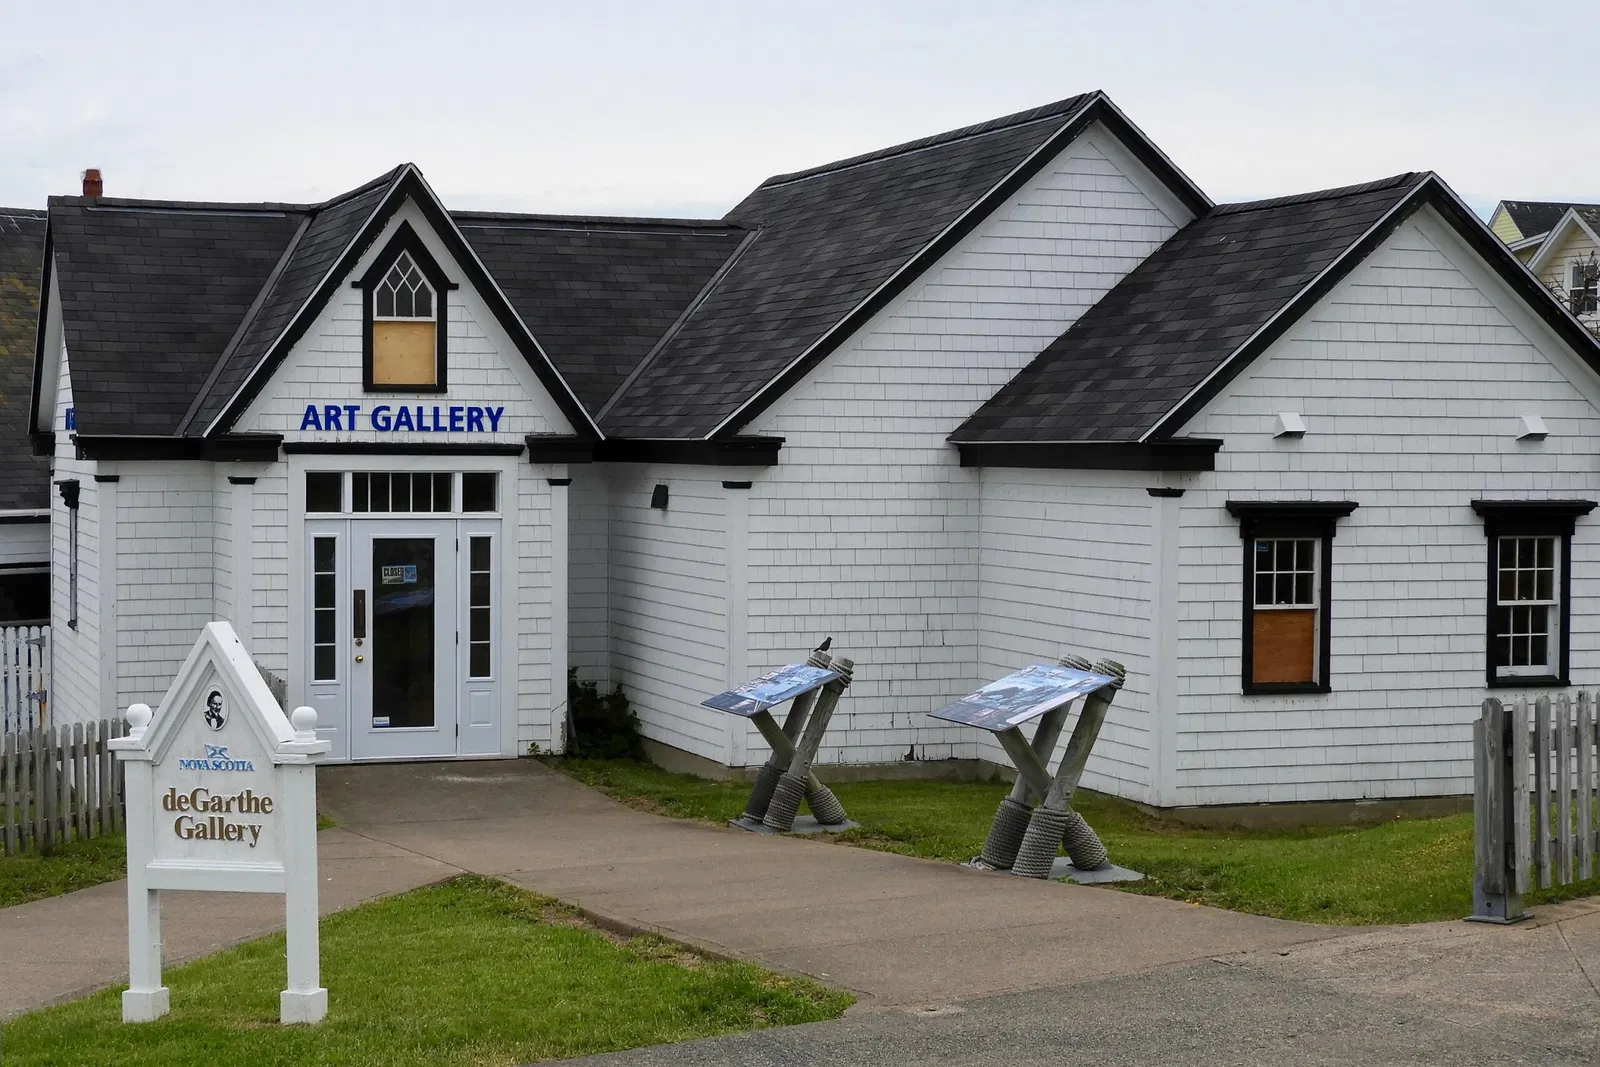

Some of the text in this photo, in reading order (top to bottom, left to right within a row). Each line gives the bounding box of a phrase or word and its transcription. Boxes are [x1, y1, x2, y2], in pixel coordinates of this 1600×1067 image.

[300, 405, 504, 432] ART GALLERY
[383, 567, 404, 577] CLOSED
[179, 759, 255, 772] NOVA SCOTIA
[162, 787, 274, 814] deGarthe
[174, 815, 262, 848] Gallery
